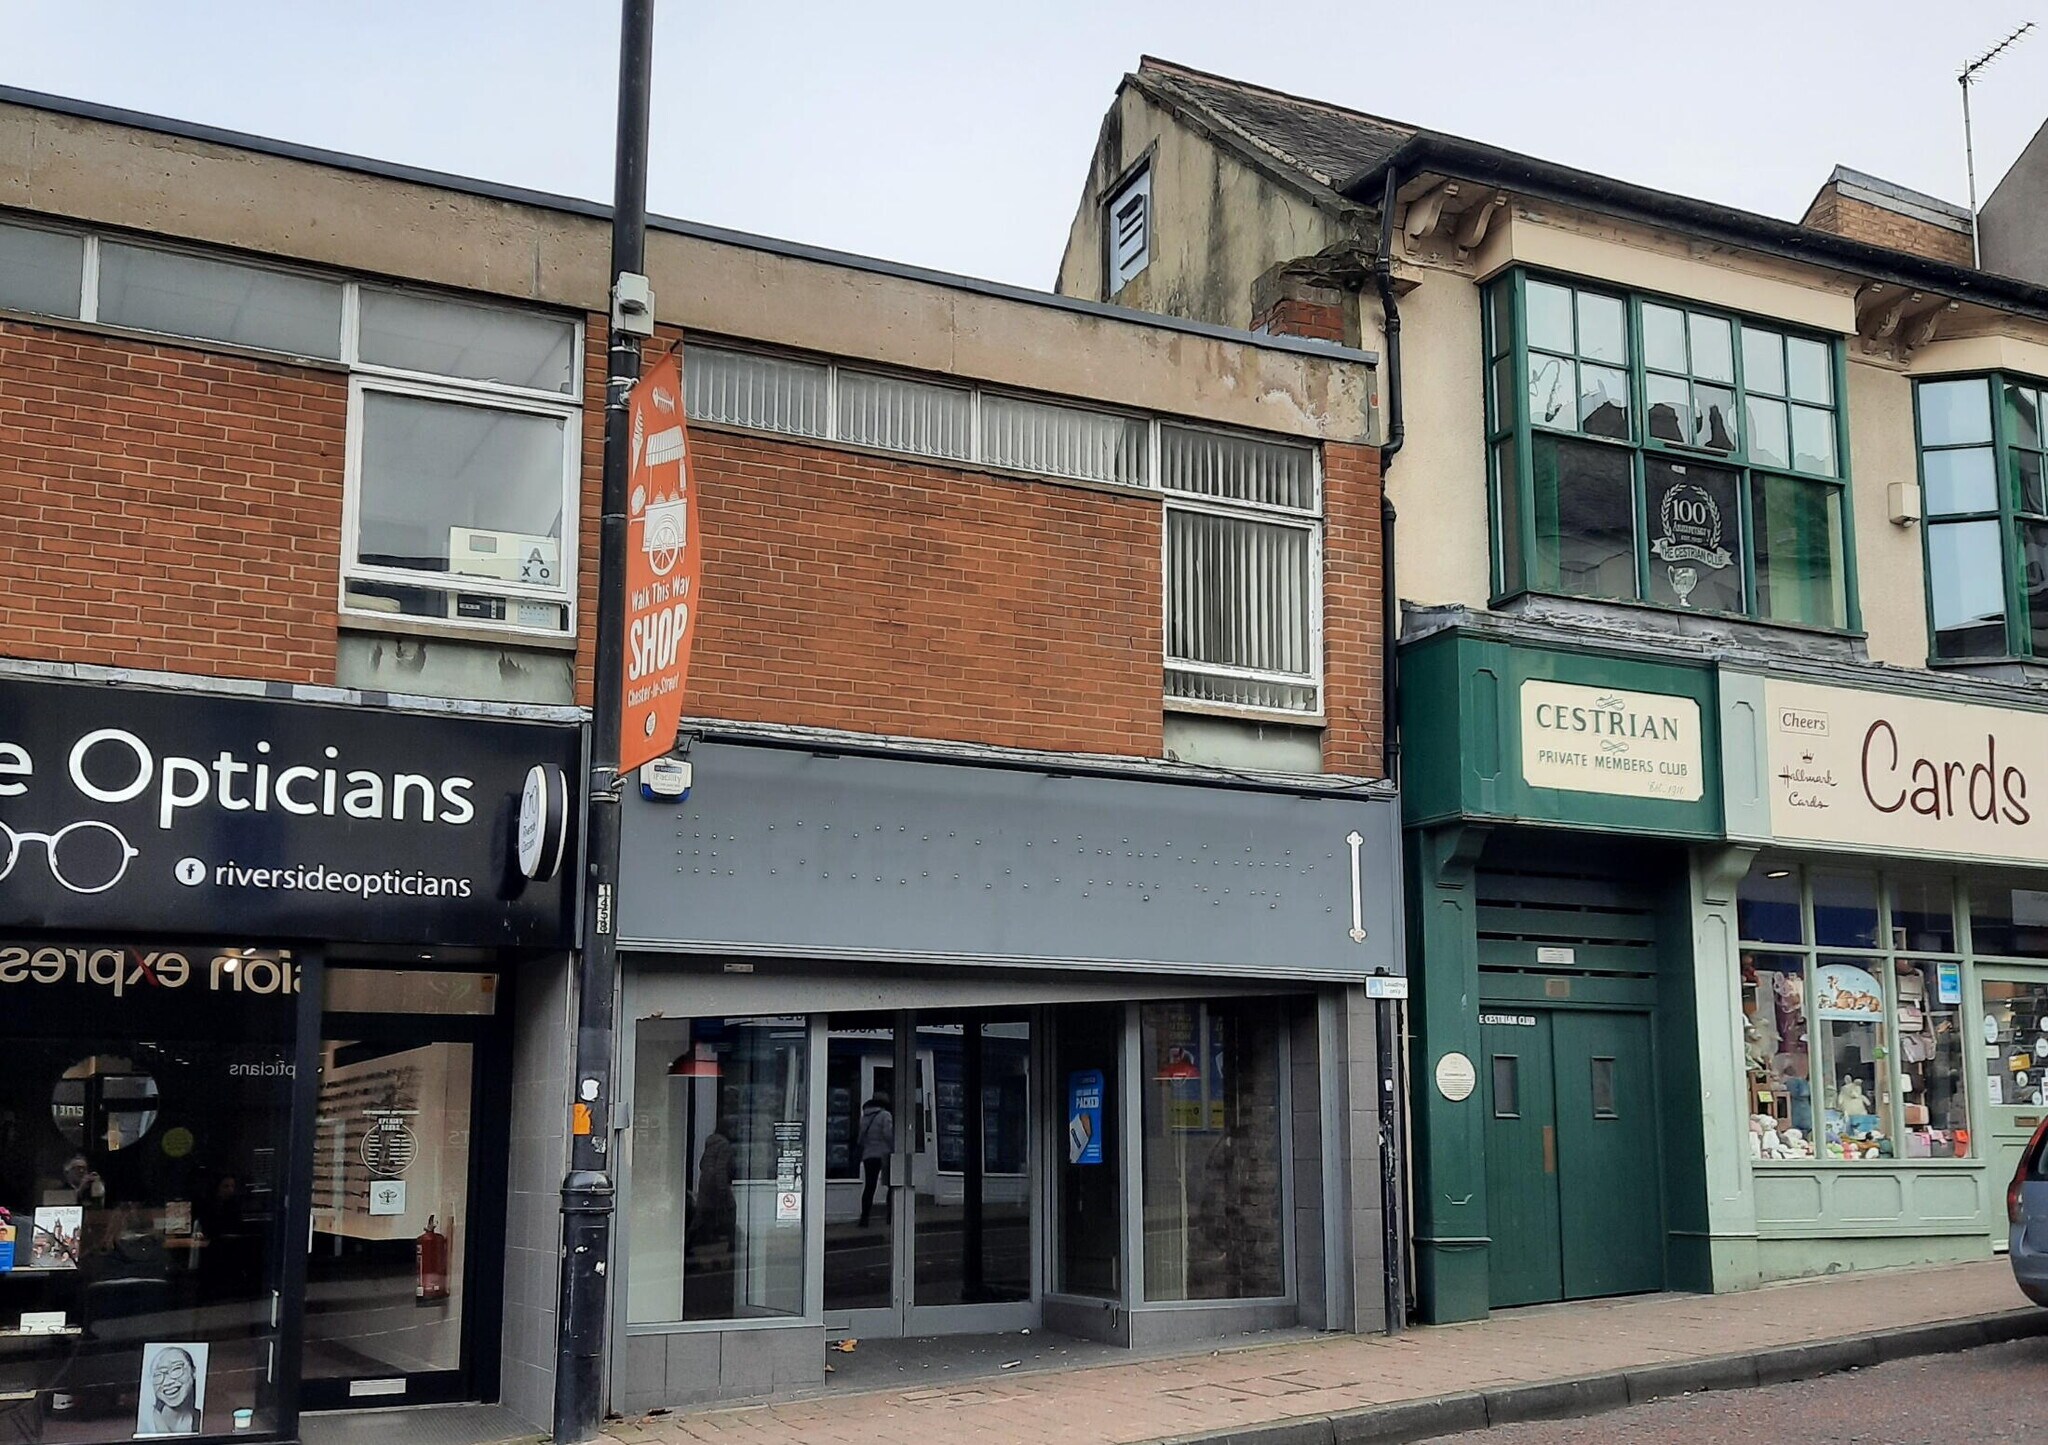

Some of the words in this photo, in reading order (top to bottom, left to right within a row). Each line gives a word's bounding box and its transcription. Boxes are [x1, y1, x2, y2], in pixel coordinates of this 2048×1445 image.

[522, 565, 532, 577] X
[540, 567, 550, 579] O
[527, 547, 545, 565] A
[631, 587, 650, 613] Walk
[652, 580, 670, 605] This
[672, 574, 690, 599] Way
[628, 603, 688, 681] SHOP
[1536, 703, 1678, 741] CESTRIAN
[1782, 712, 1826, 731] Cheers
[69, 728, 475, 830] Opticians
[1539, 750, 1588, 767] PRIVATE
[1594, 755, 1654, 774] MEMBERS
[1659, 761, 1688, 777] CLUB
[1778, 764, 1838, 788] Hallmark
[1862, 719, 2030, 826] Cards
[1788, 791, 1829, 808] Cards
[215, 861, 472, 899] riversideopticians
